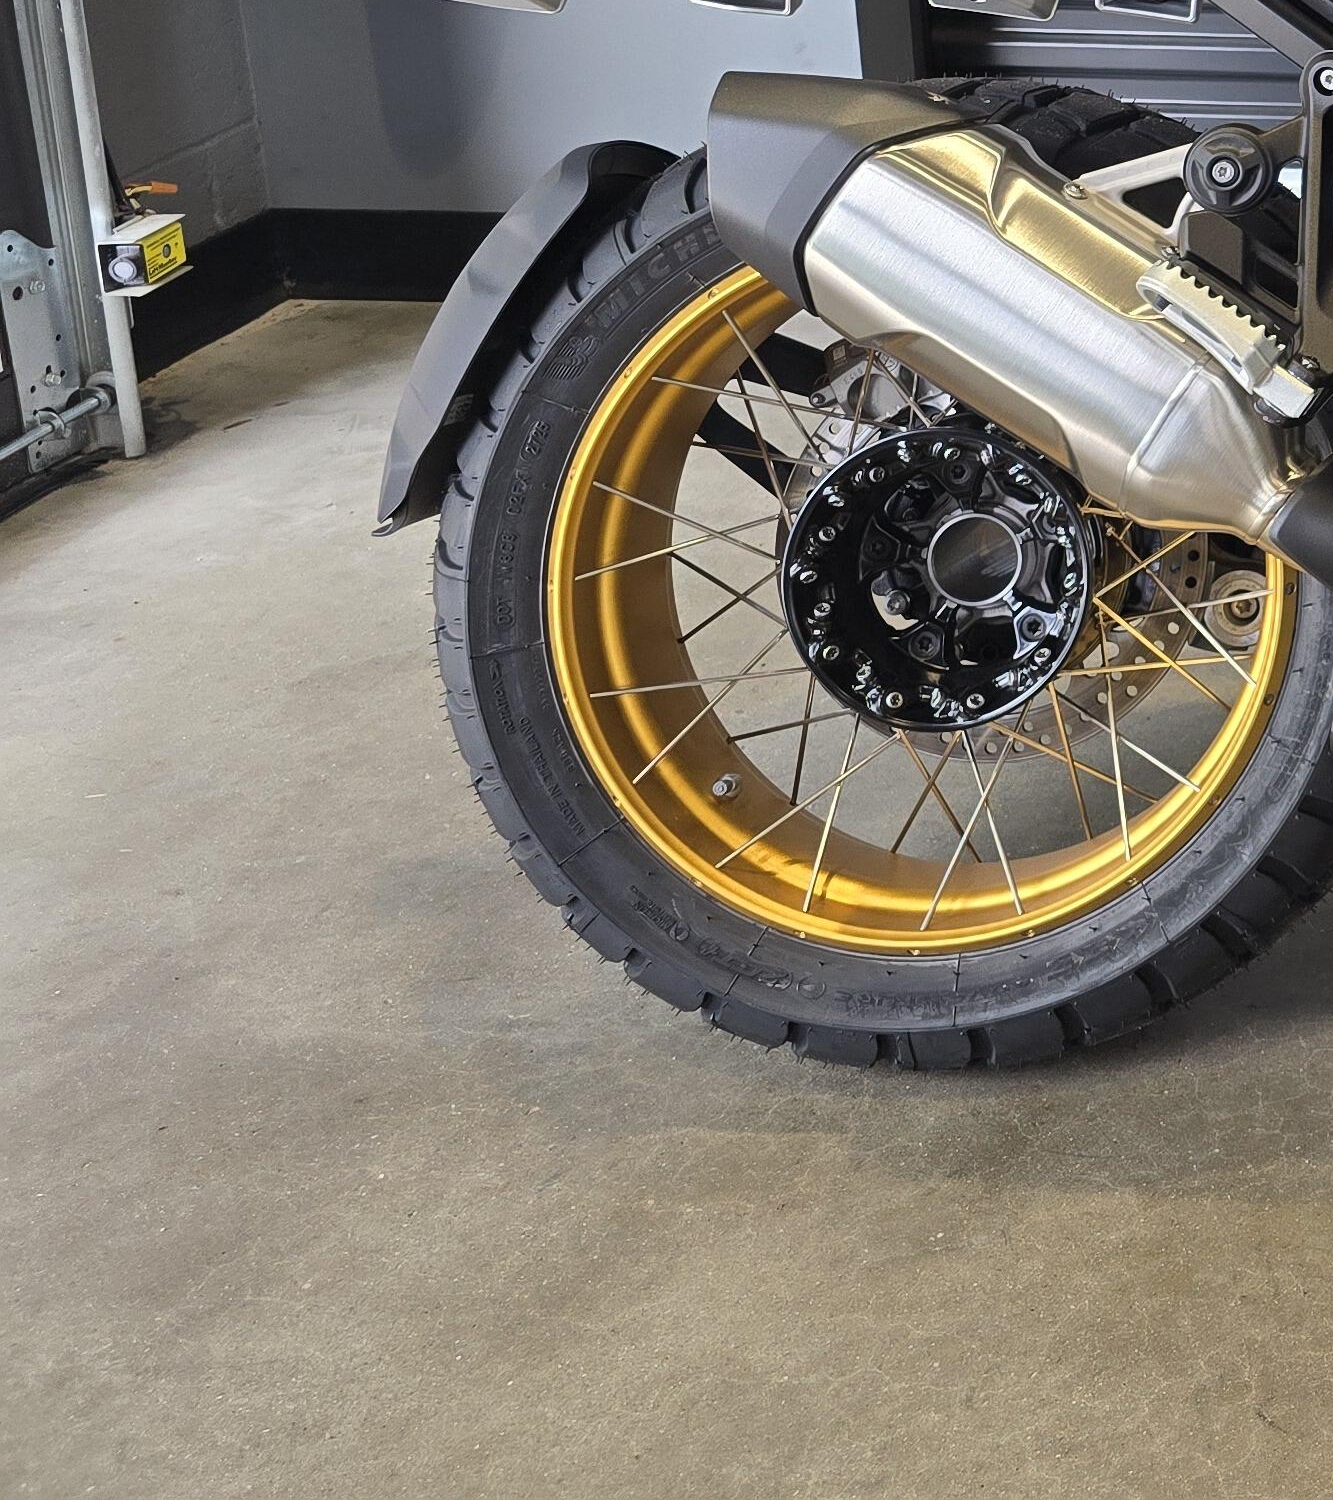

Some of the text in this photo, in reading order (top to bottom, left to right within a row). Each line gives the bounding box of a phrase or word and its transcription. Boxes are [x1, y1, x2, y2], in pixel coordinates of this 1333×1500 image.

[518, 715, 554, 785] THAILAND
[548, 781, 563, 800] IN
[557, 799, 586, 837] MADE
